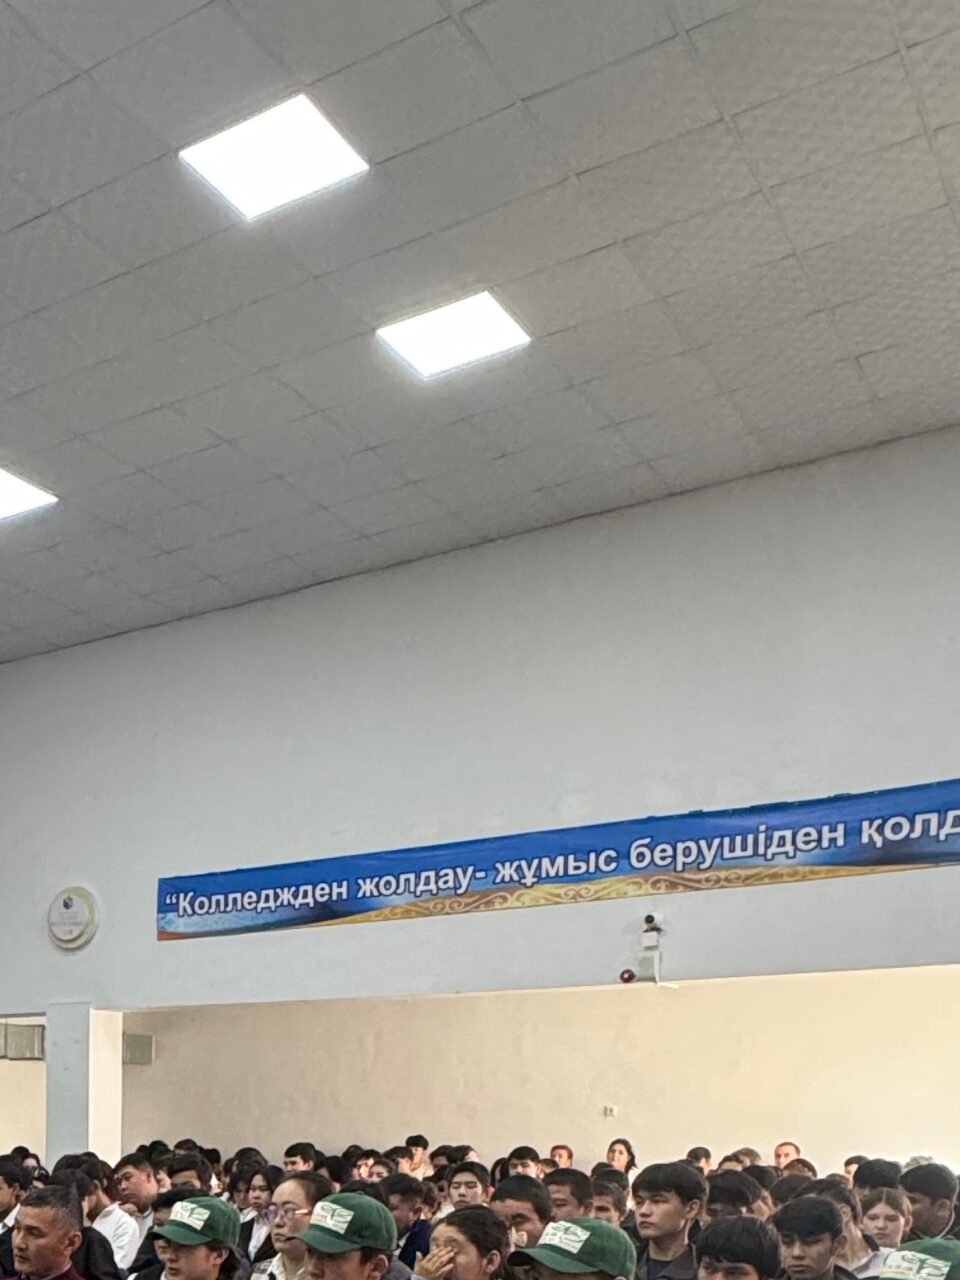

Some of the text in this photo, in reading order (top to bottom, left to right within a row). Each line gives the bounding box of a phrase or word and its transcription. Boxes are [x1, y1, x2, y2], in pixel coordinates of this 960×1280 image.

[357, 865, 486, 896] жолдау-
[495, 849, 618, 887] жұмыс
[629, 823, 845, 871] берушіден
